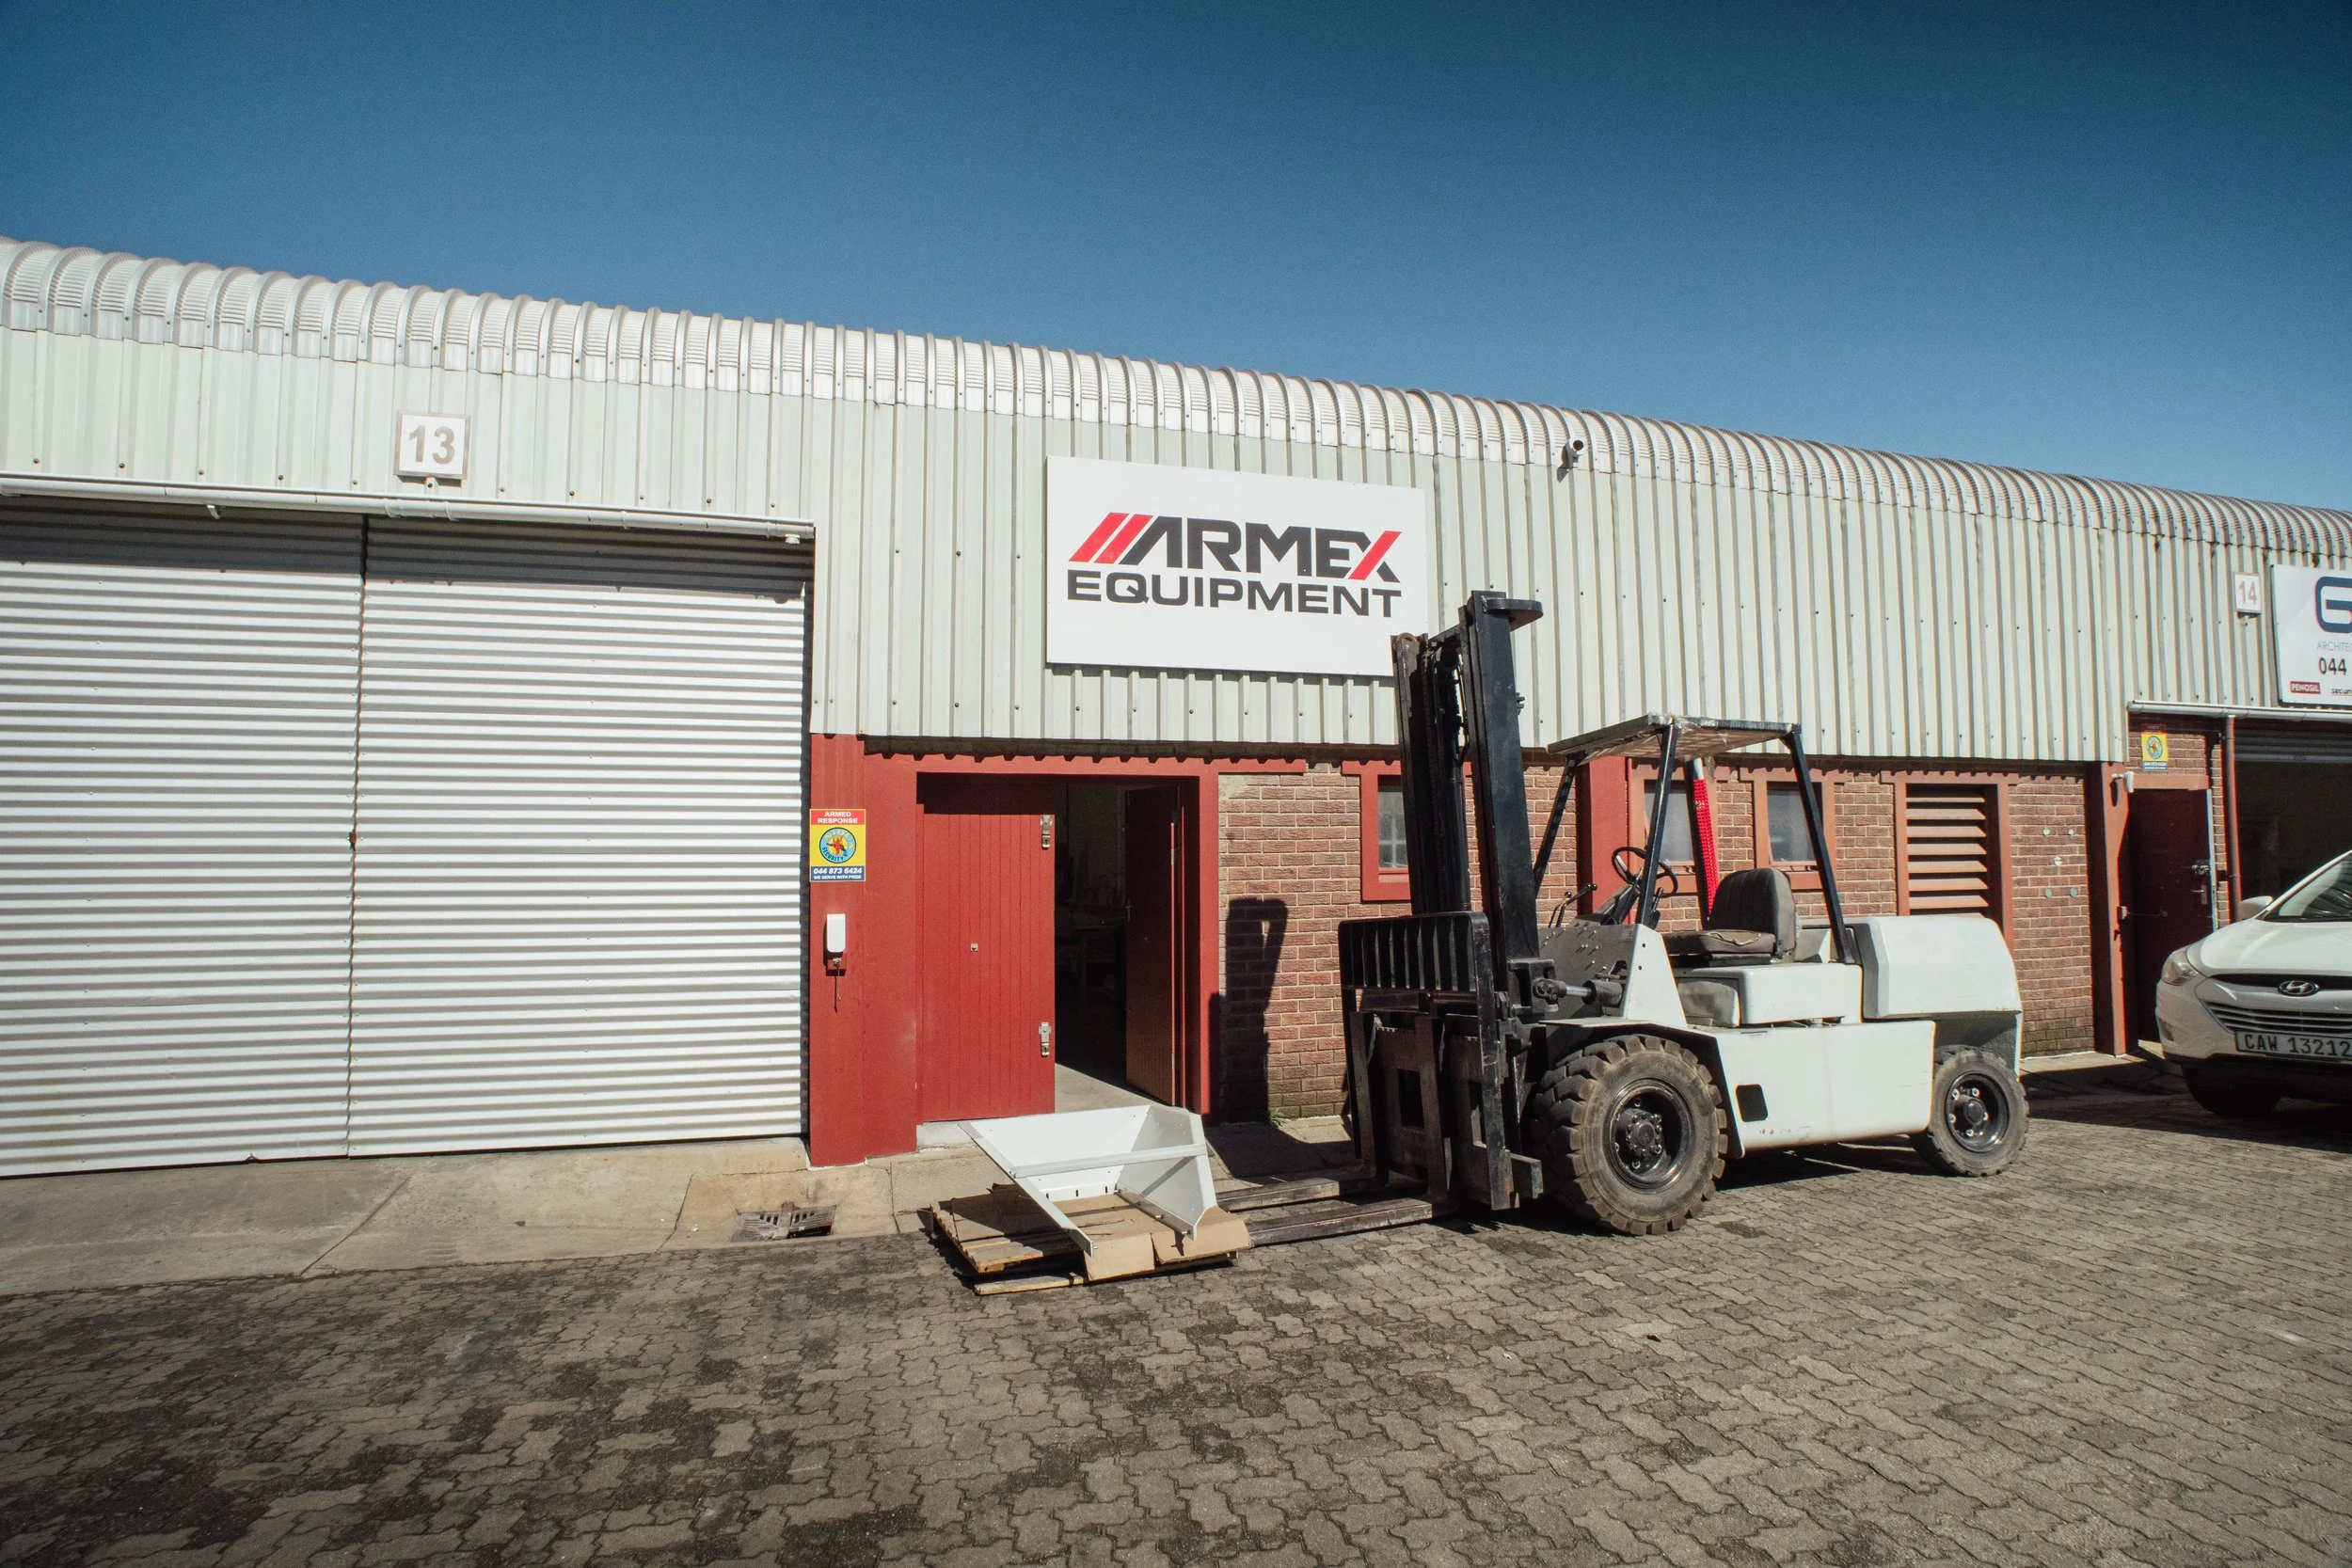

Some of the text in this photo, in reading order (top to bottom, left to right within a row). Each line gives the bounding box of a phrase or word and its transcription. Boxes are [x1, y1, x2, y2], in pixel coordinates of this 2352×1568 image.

[408, 425, 455, 465] 13
[1119, 515, 1402, 583] ARMEX
[1067, 569, 1403, 618] EQUIPMENT
[2238, 580, 2257, 604] 14
[2318, 657, 2347, 675] 044
[822, 847, 844, 862] SECURITY
[2245, 1035, 2277, 1051] CAW
